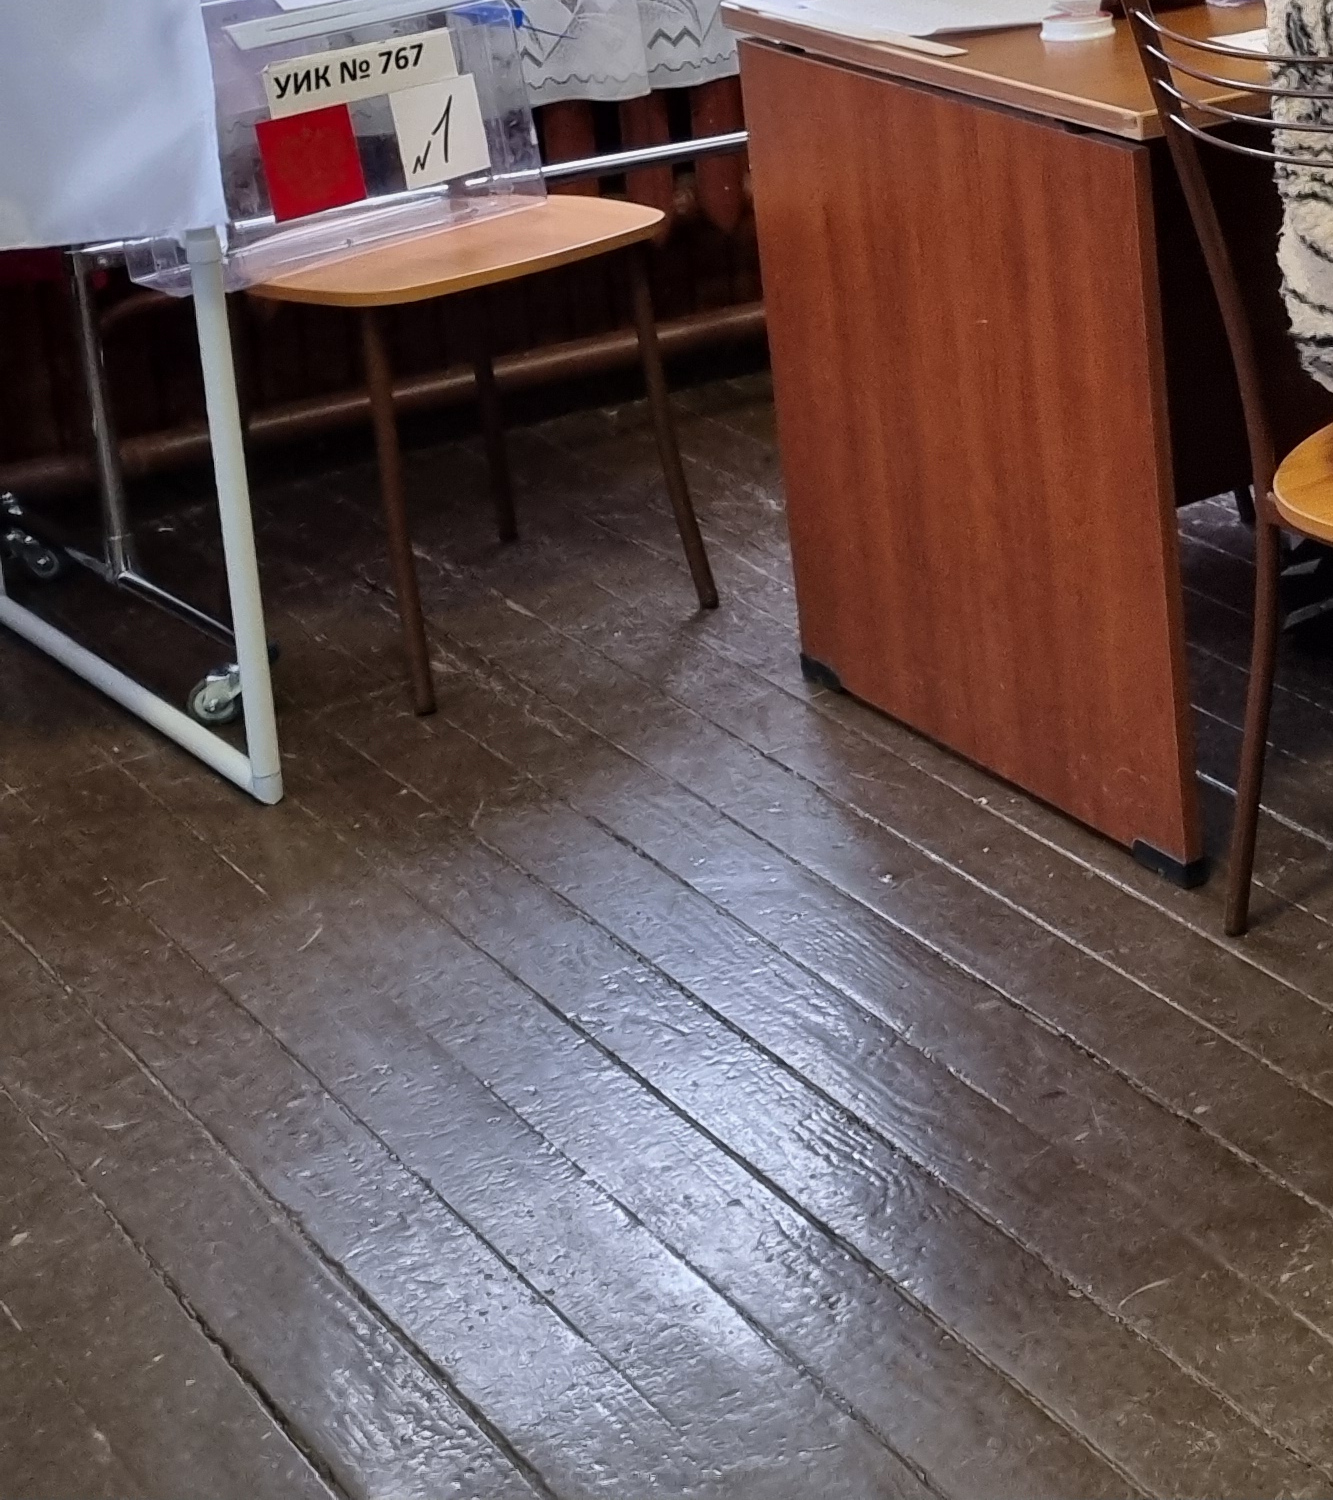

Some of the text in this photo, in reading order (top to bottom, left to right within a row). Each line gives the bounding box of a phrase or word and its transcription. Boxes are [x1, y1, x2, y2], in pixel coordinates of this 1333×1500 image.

[273, 43, 424, 100] УИК № 767
